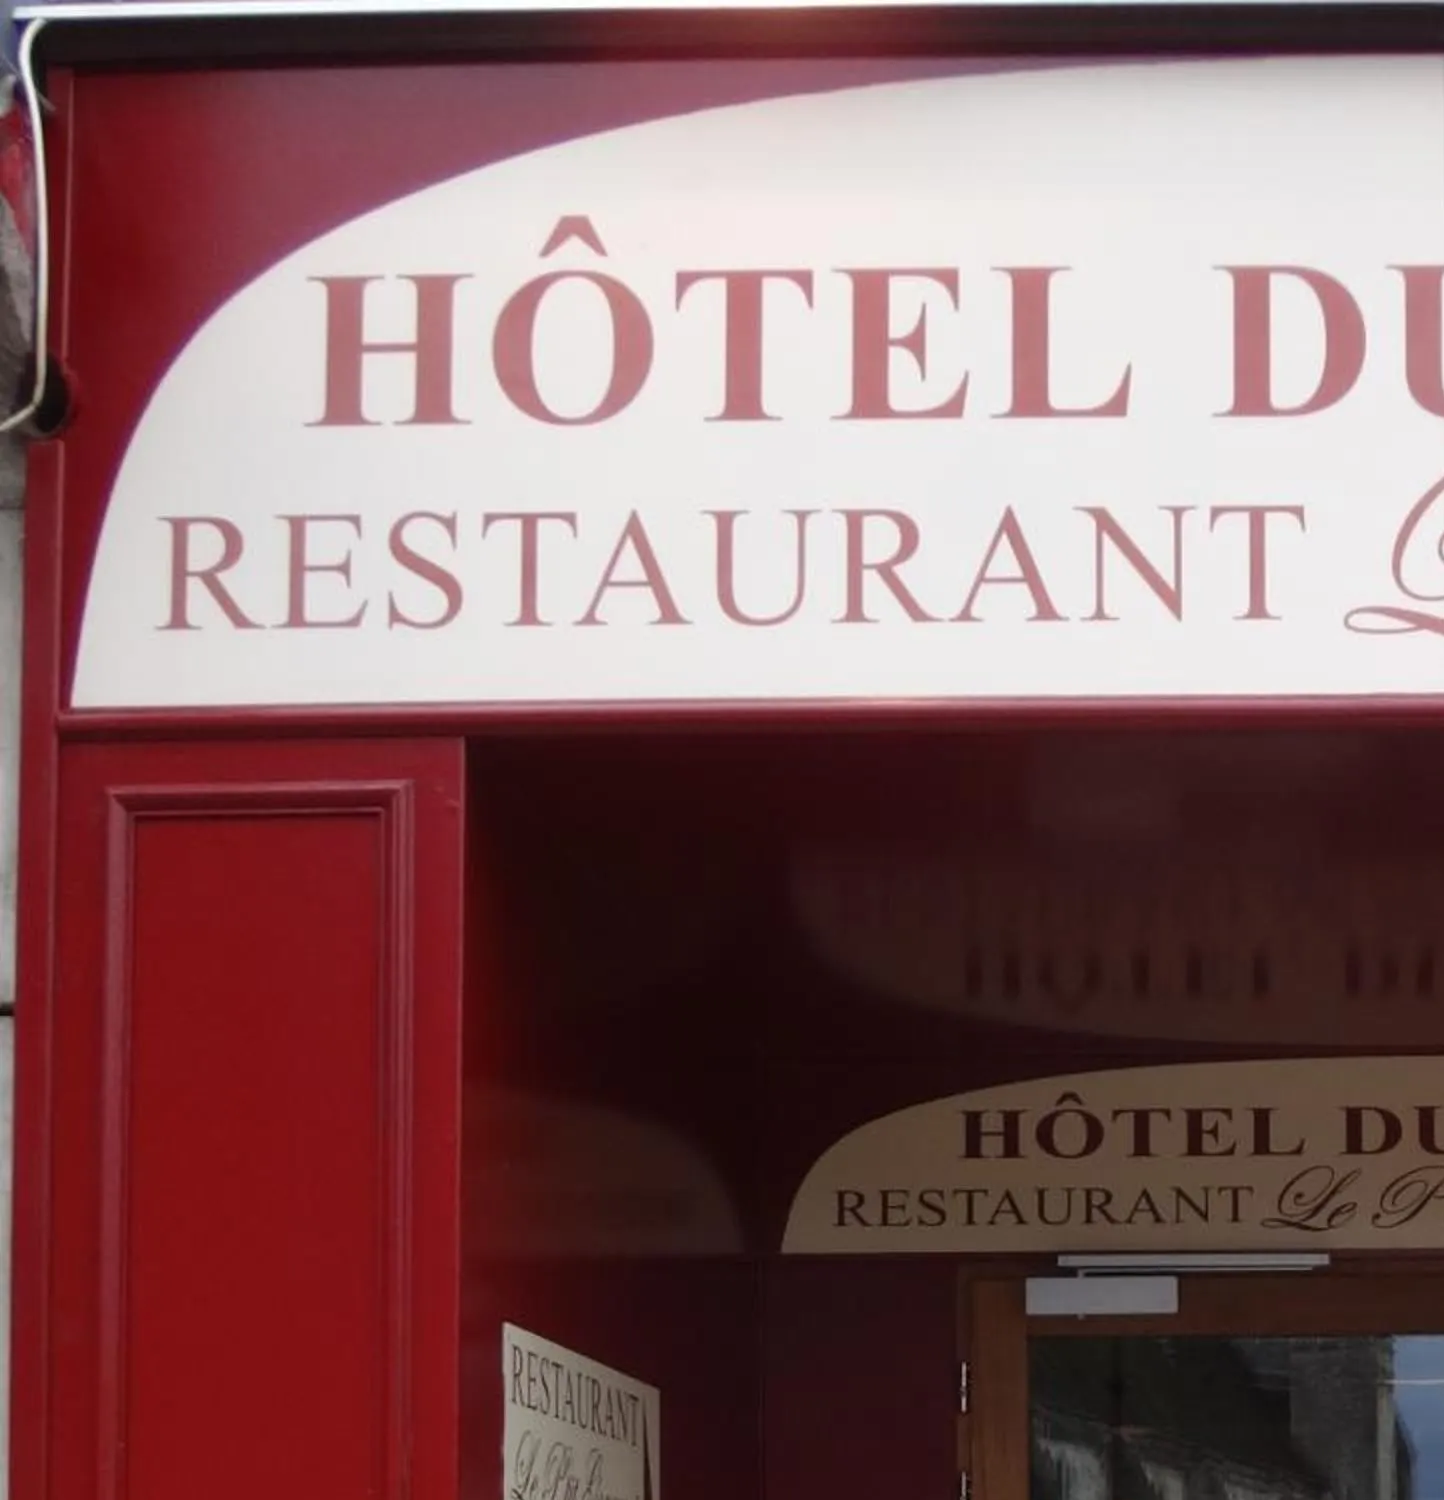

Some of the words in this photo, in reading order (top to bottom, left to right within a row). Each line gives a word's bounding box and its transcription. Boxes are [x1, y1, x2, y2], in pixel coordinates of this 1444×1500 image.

[303, 214, 1133, 428] HÔTEL
[155, 504, 1307, 633] RESTAURANT
[958, 1092, 1306, 1160] HÔTEL
[833, 1185, 1254, 1228] RESTAURANT
[1260, 1165, 1358, 1232] Le
[511, 1343, 640, 1447] RESTAURANT
